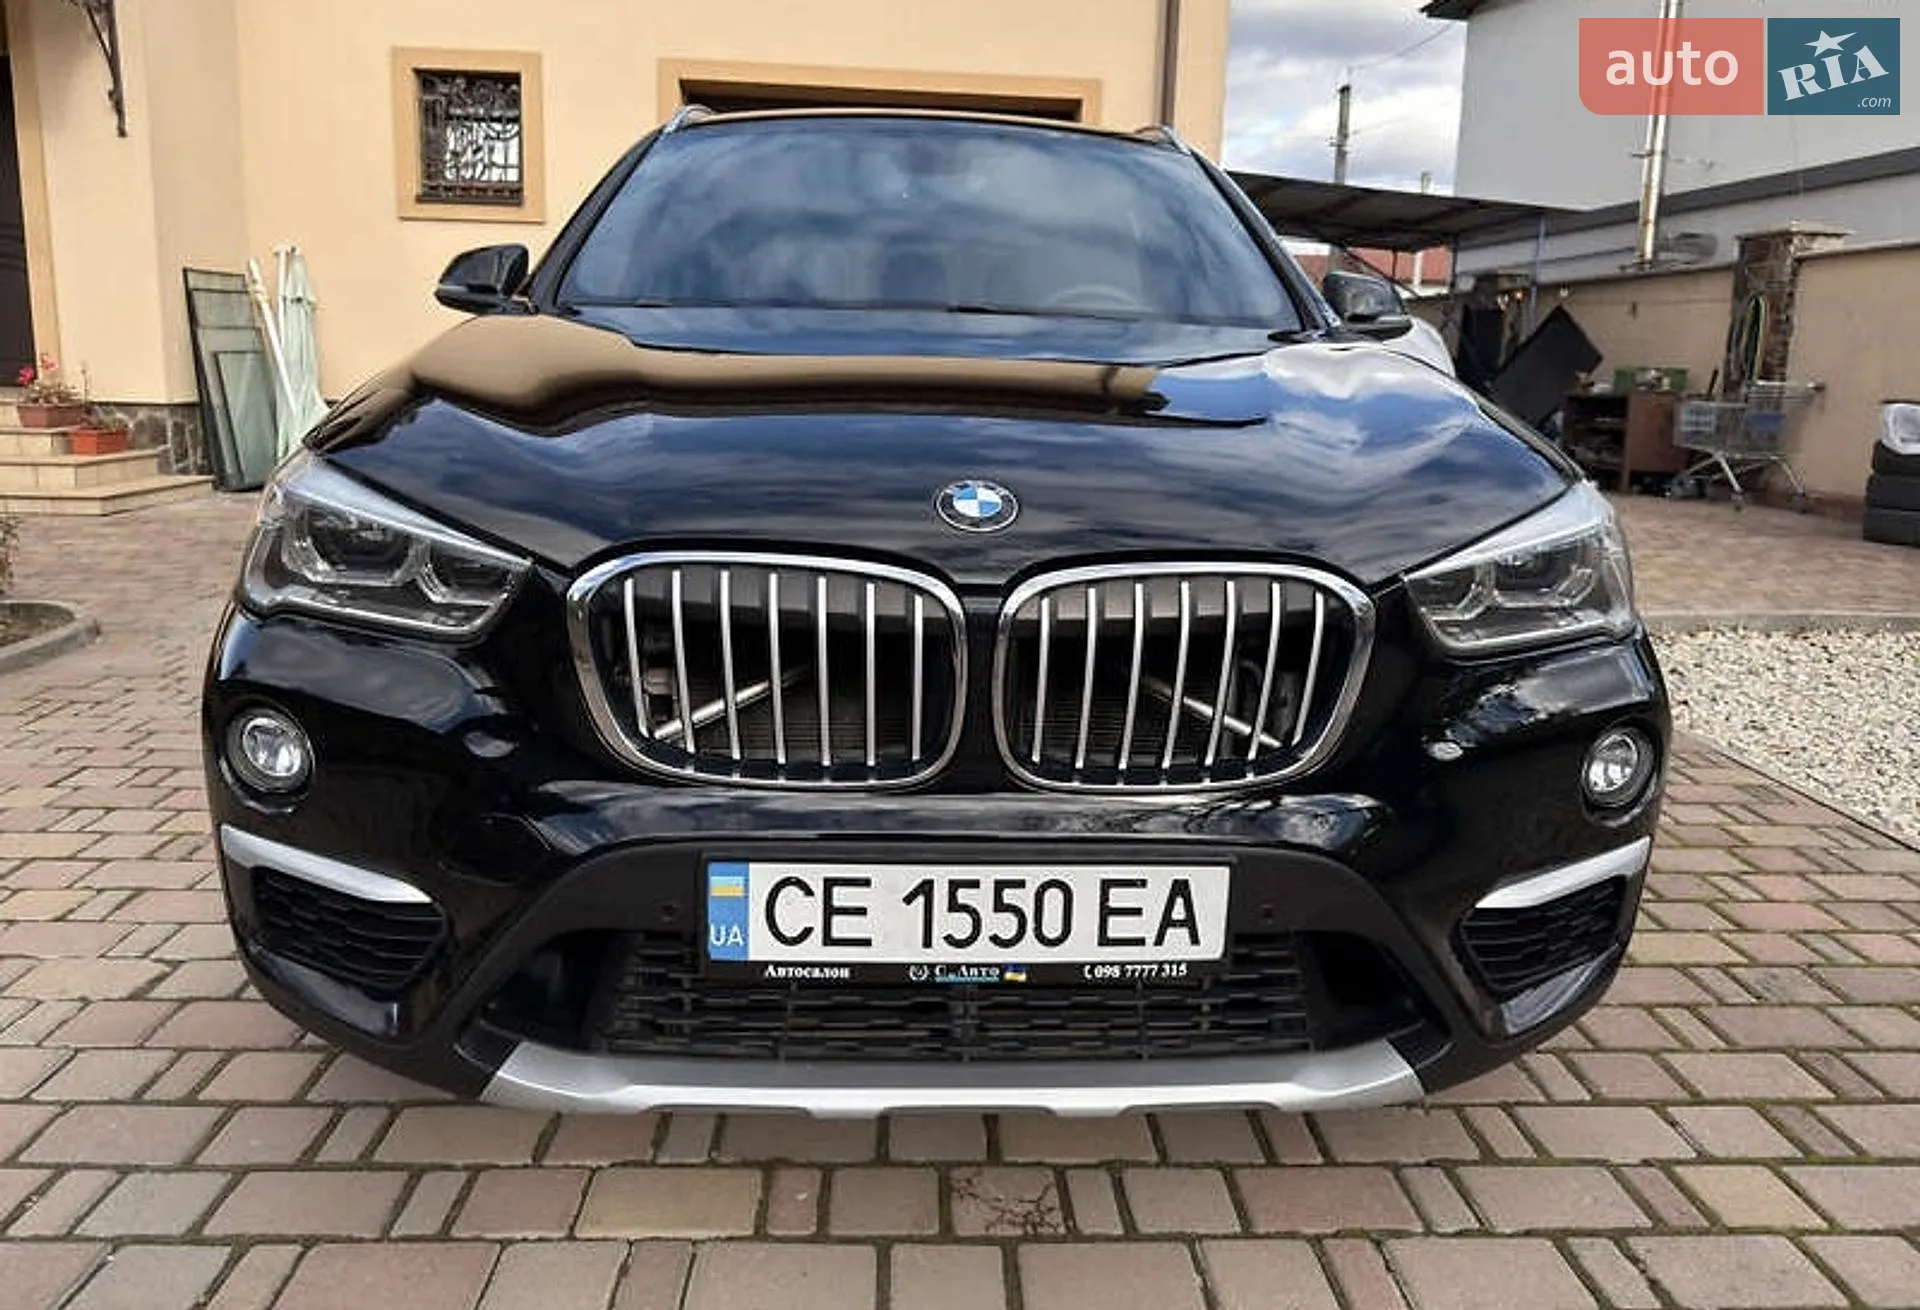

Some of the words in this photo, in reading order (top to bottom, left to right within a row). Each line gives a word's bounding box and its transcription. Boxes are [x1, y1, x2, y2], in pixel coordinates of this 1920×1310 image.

[710, 924, 744, 946] UA
[765, 876, 872, 947] CE
[902, 878, 1074, 949] 1550
[1097, 878, 1200, 947] EA
